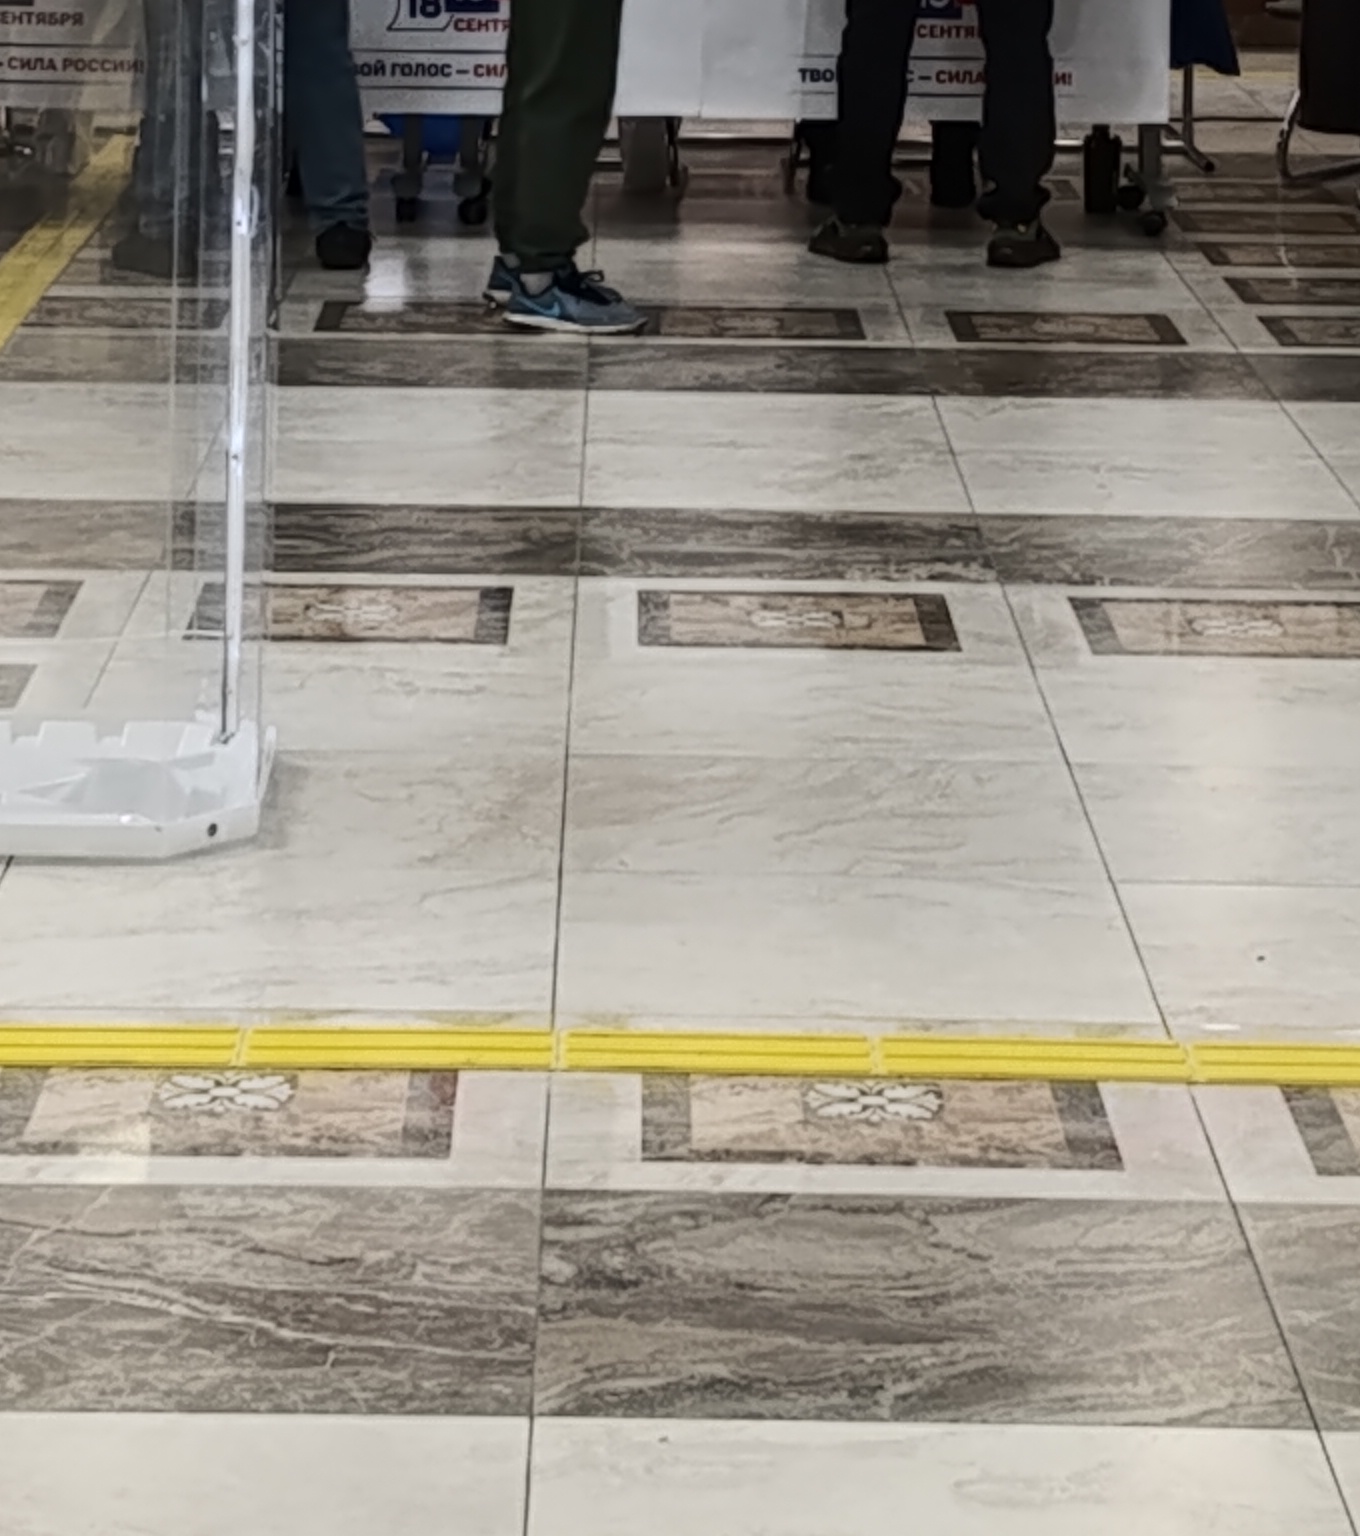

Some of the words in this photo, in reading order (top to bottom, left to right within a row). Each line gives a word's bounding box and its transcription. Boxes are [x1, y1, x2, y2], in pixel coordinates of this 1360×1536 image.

[7, 56, 58, 73] СИЛА
[61, 58, 145, 75] РОССИИ!
[390, 62, 453, 78] ГОЛОС
[935, 69, 986, 86] СИЛА
